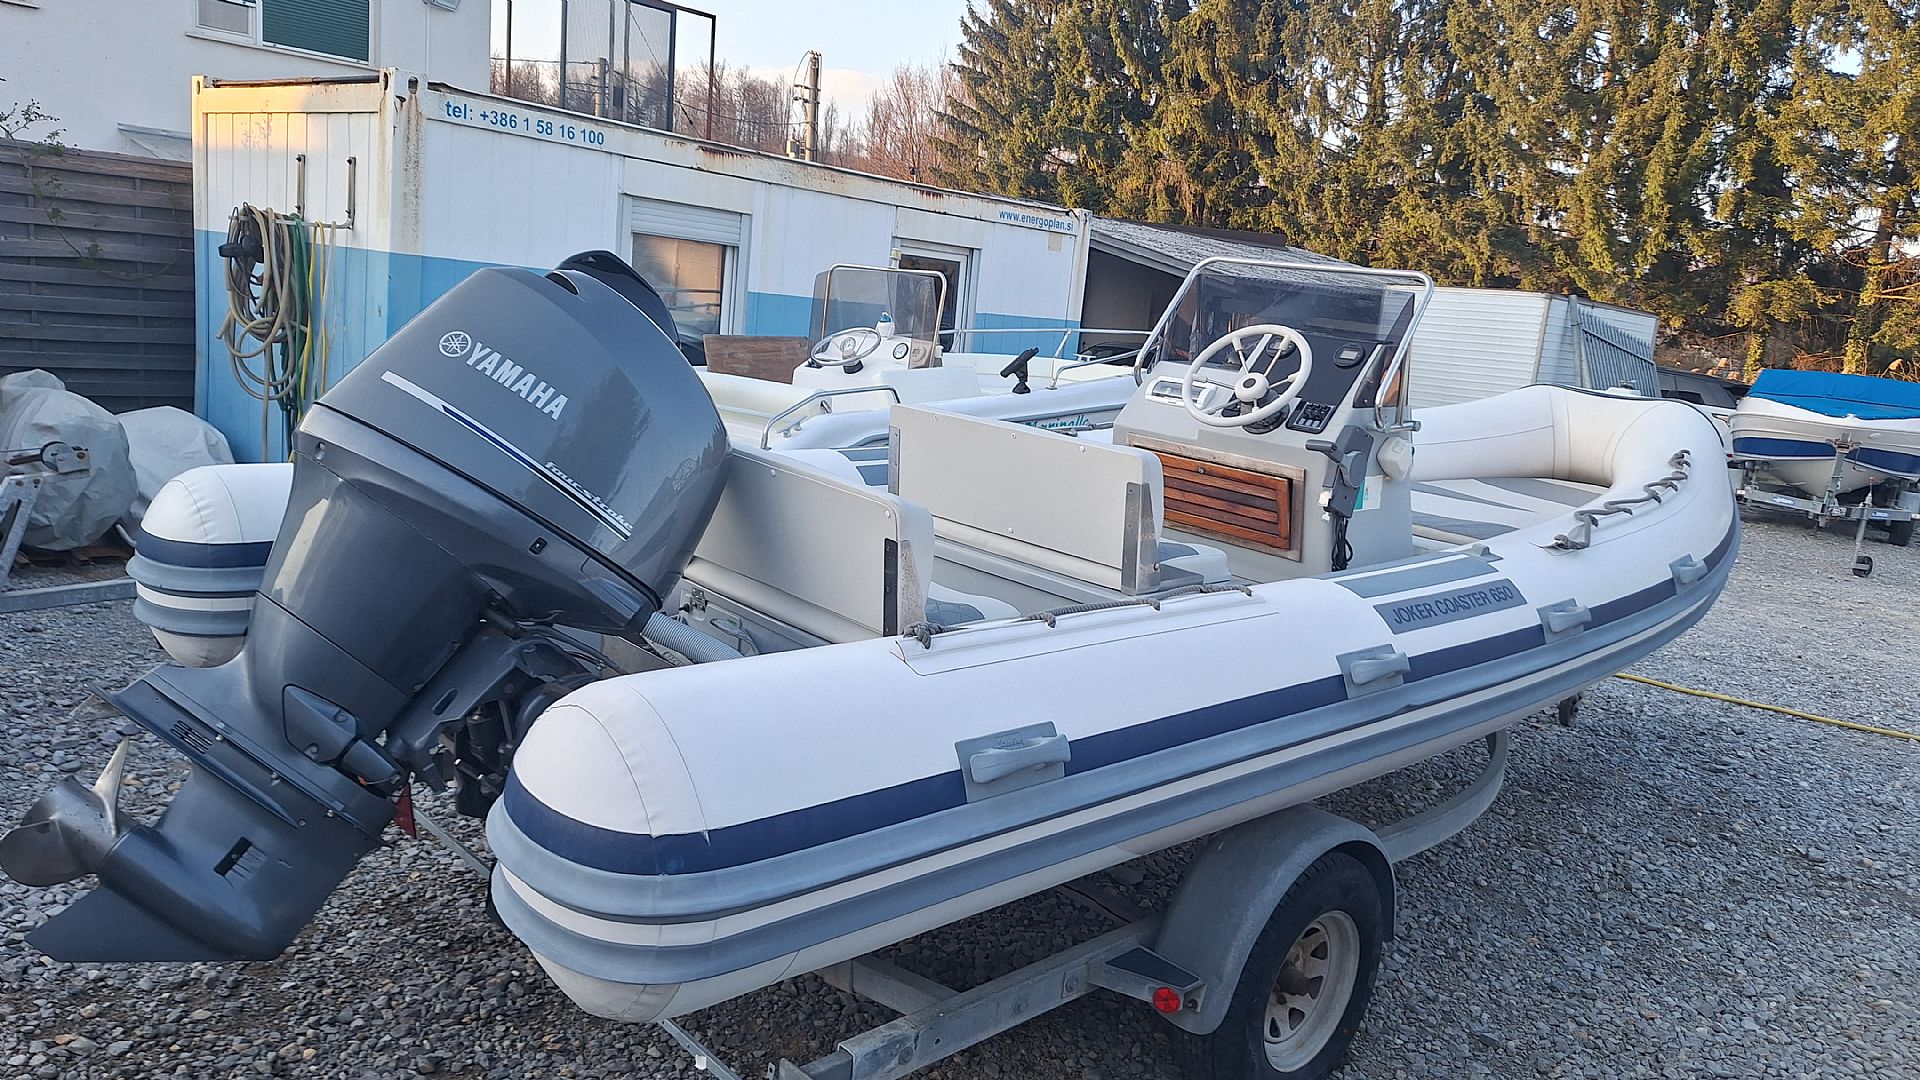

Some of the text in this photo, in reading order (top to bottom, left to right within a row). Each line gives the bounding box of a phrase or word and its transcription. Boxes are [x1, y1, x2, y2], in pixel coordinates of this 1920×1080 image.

[445, 101, 604, 145] tel: +386 1 58 16 100
[999, 209, 1074, 231] www.energoplan.si
[466, 342, 568, 421] YAMAHA
[1392, 586, 1513, 624] JOKER COASTER 650
